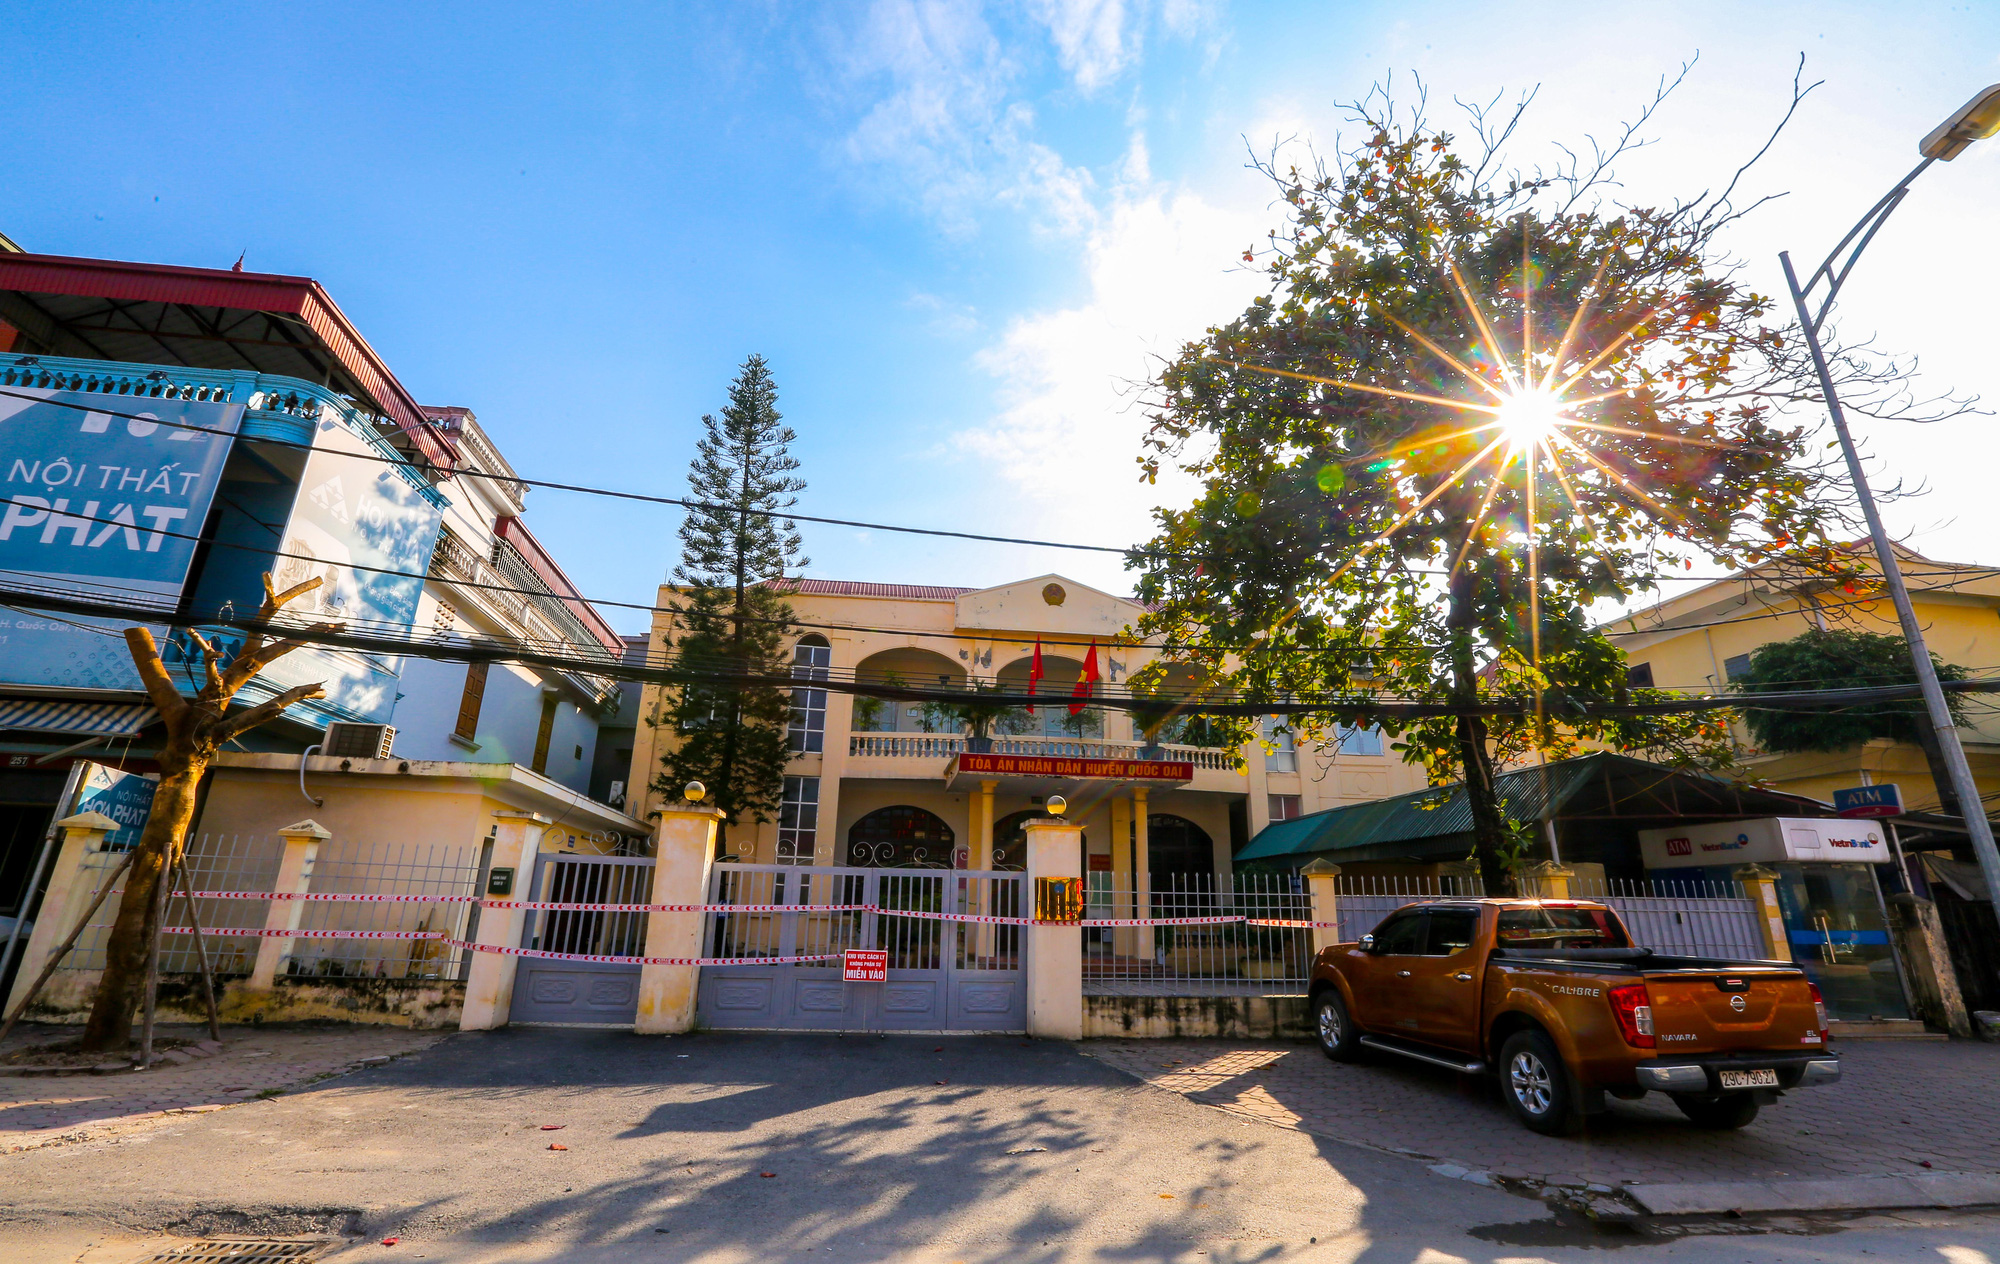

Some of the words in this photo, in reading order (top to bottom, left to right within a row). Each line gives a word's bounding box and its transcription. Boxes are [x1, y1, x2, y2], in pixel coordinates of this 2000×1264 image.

[7, 456, 87, 492] NỘI
[98, 462, 201, 496] THẤT
[0, 494, 188, 553] PHÁT
[15, 620, 46, 631] Quốc
[11, 755, 28, 766] 257
[968, 755, 992, 770] TÒA
[997, 756, 1015, 771] ÁN
[1018, 757, 1051, 773] NHÂN
[1056, 759, 1082, 774] DÂN
[1086, 760, 1124, 778] HUYỆN
[1128, 761, 1159, 777] QUỐC
[1163, 765, 1183, 777] OAI
[1848, 789, 1883, 805] ATM
[1666, 839, 1690, 855] ATM
[846, 967, 867, 979] MIỄN
[868, 969, 884, 979] VÀO
[1552, 985, 1600, 997] CALIBRE
[1661, 1033, 1698, 1041] NAVARA
